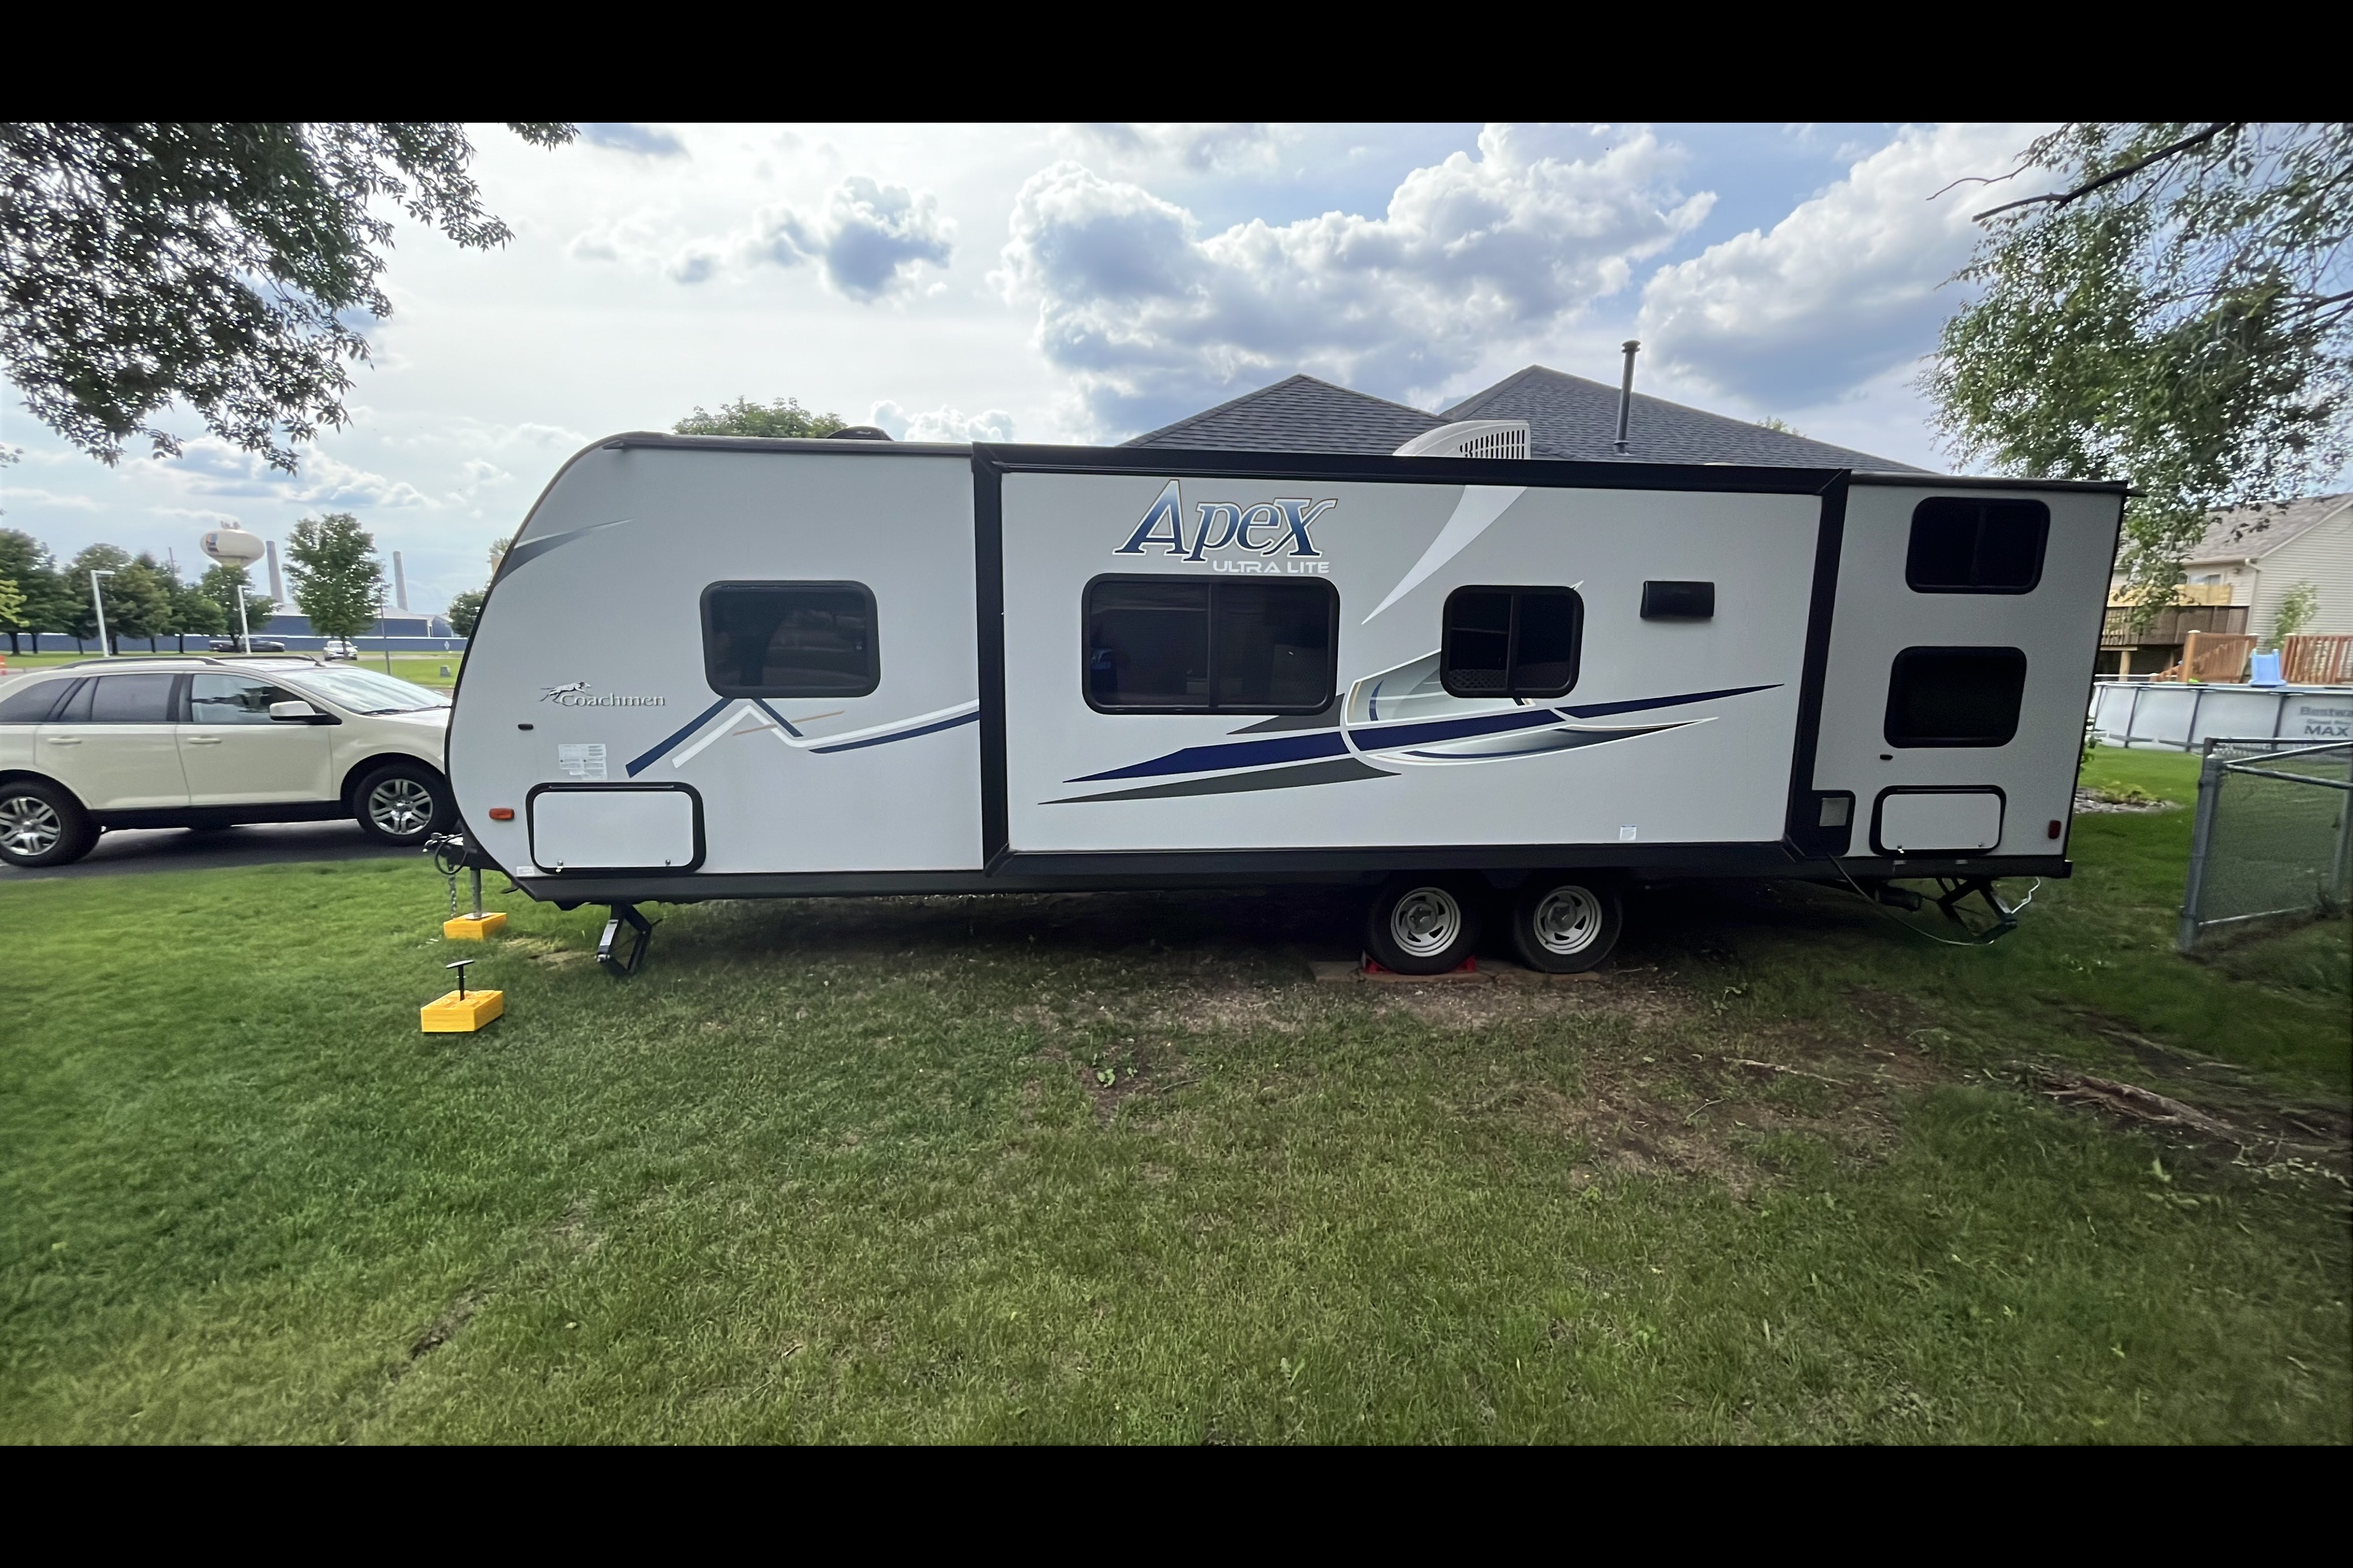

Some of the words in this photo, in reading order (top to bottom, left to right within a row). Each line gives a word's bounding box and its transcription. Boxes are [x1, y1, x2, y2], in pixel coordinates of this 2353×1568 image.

[1113, 479, 1338, 563] Apex
[1213, 560, 1282, 573] ULTRA
[1287, 561, 1330, 574] LITE
[560, 693, 666, 707] Coachmen
[2304, 725, 2348, 737] MAX
